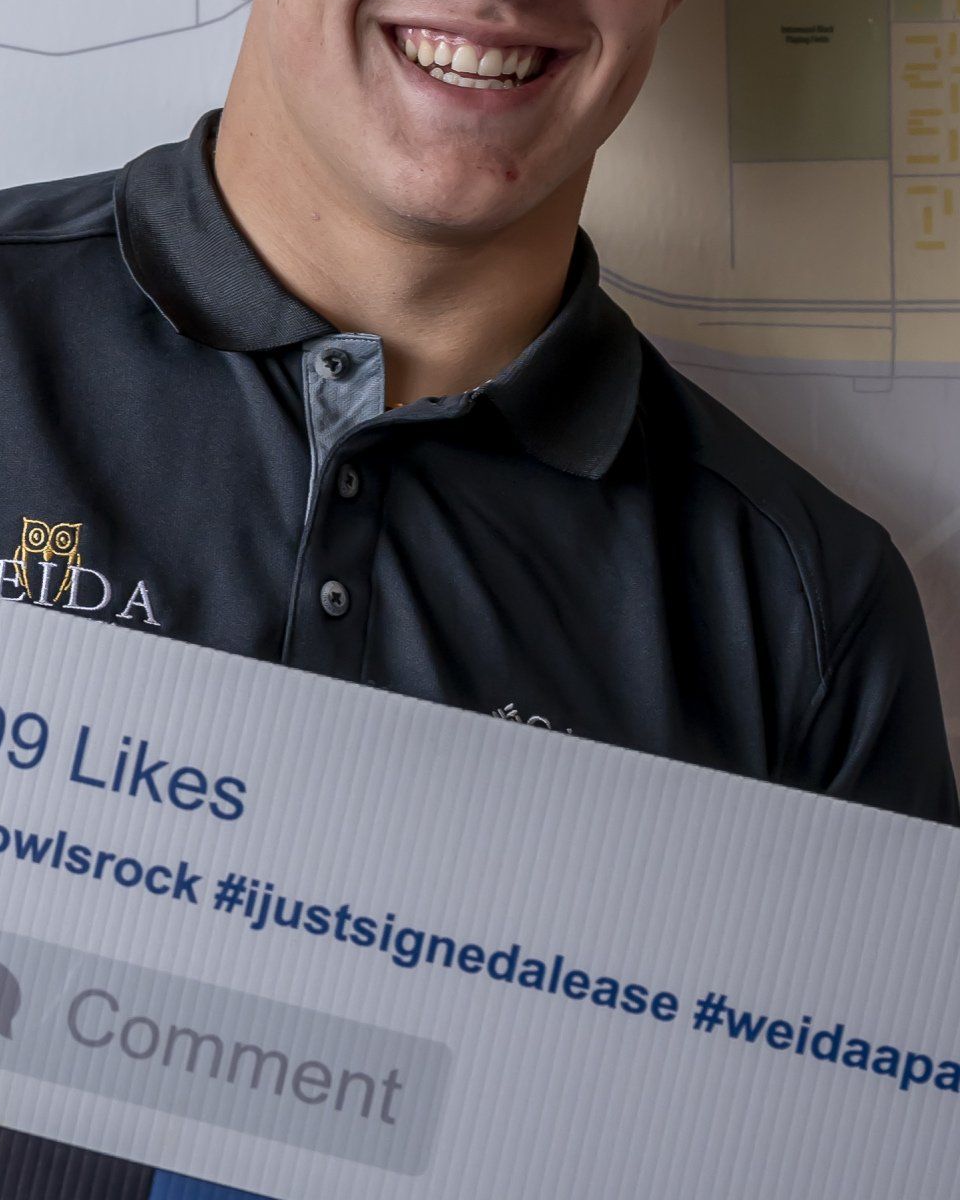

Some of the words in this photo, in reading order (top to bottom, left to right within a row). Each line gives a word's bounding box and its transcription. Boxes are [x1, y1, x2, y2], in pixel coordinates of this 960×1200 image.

[69, 725, 247, 822] Likes
[213, 872, 680, 1022] #ijustsignedalease
[692, 992, 960, 1093] #weidaapa
[67, 988, 403, 1125] Comment
